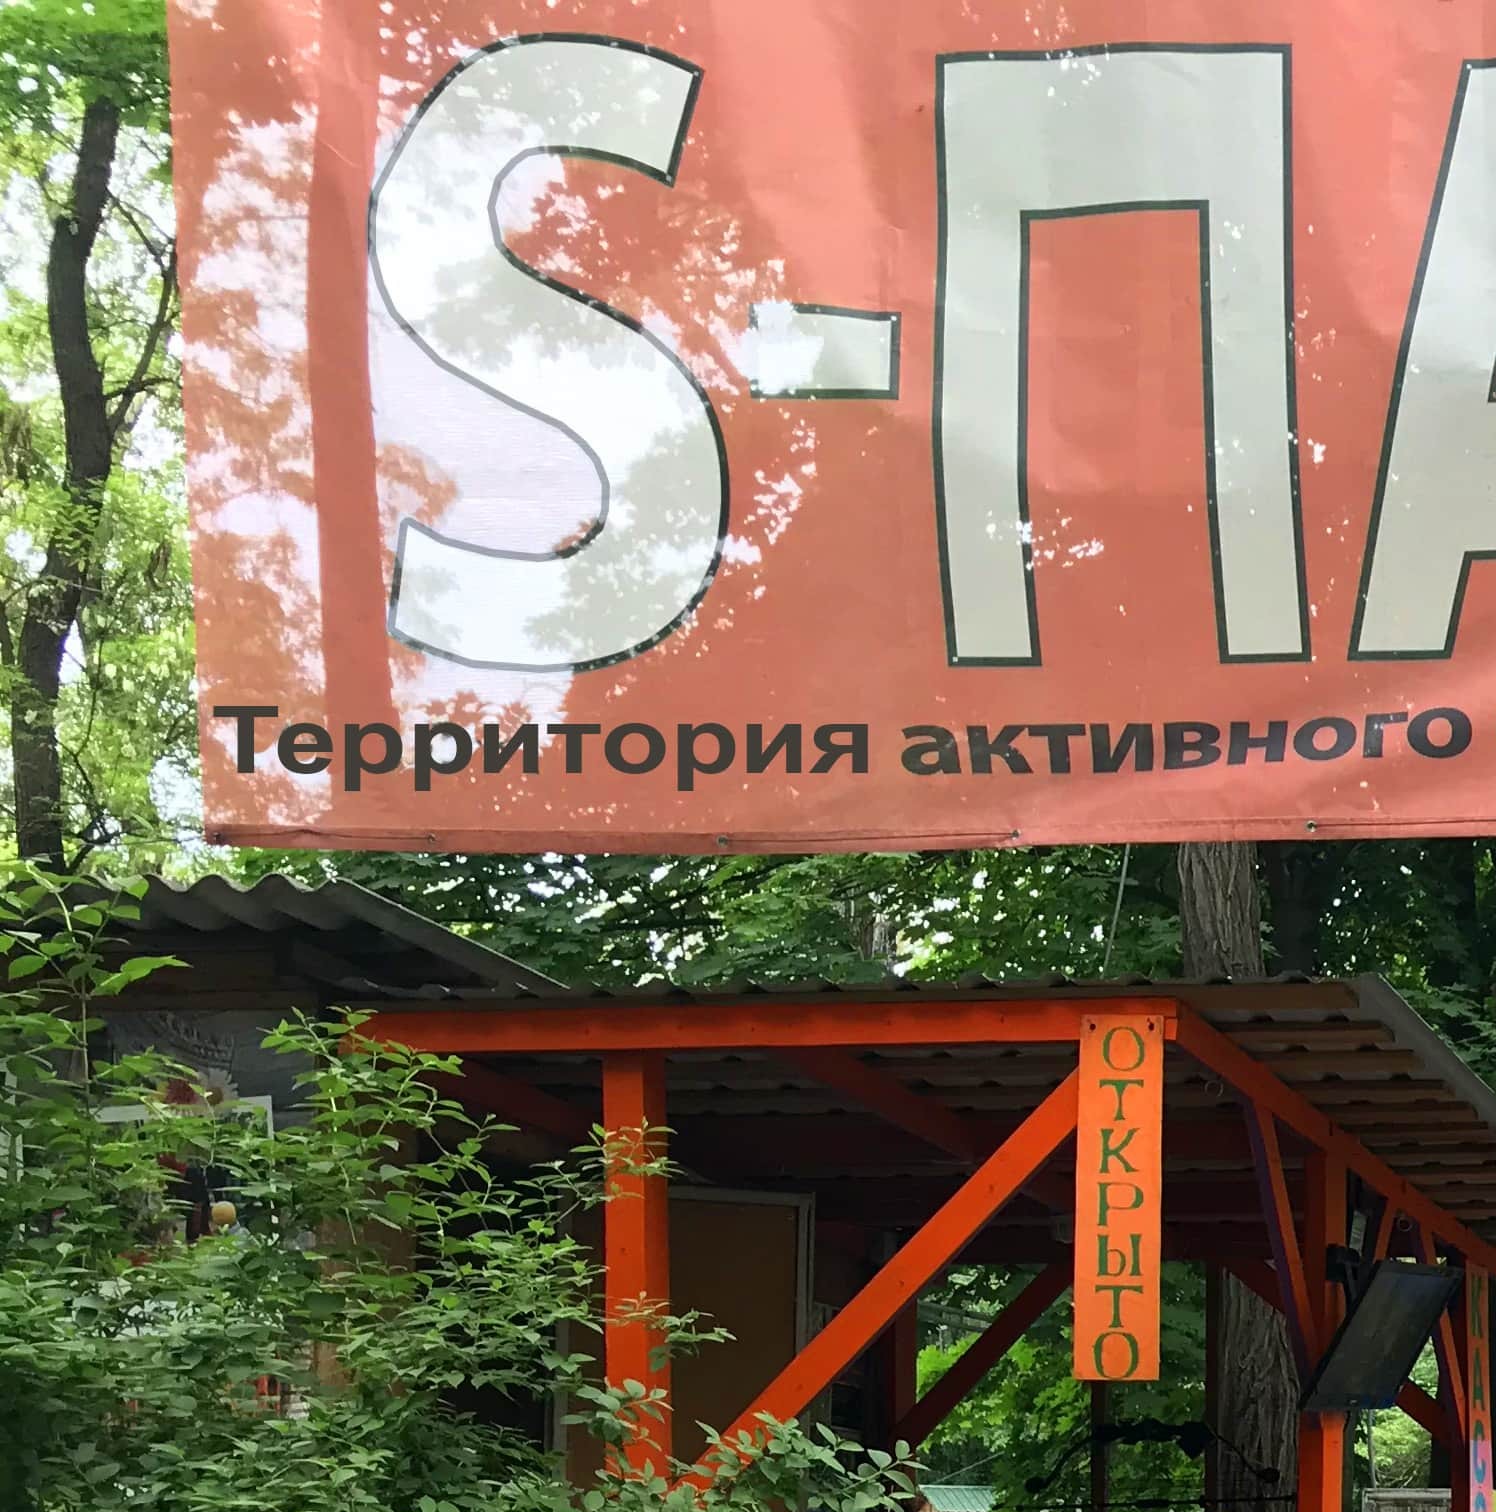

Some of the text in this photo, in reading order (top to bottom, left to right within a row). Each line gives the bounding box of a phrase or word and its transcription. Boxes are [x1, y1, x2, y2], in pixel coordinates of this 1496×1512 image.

[214, 704, 873, 791] Территория
[900, 704, 1472, 778] активного
[1093, 1025, 1147, 1379] ОТКРЫТО
